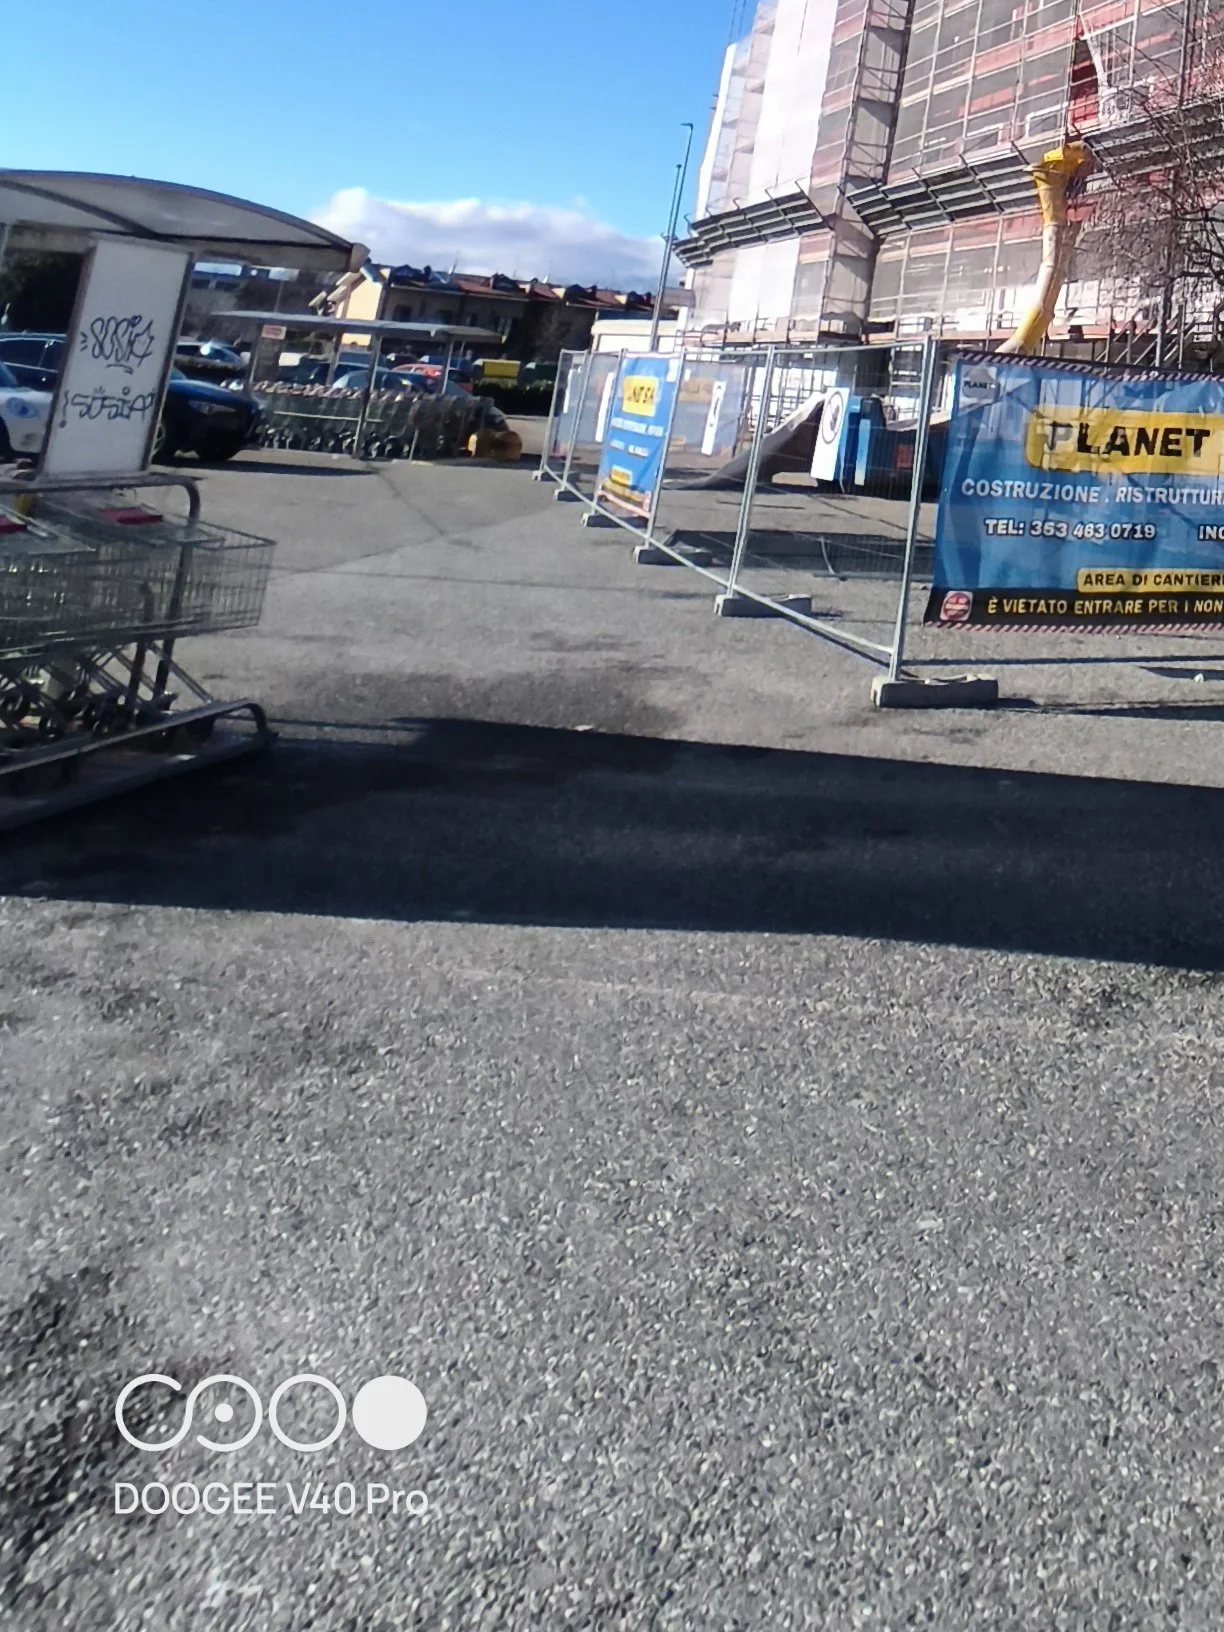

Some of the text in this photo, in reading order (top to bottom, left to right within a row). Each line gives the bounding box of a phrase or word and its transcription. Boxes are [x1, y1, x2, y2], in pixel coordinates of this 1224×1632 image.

[1046, 421, 1211, 459] PLANET
[962, 478, 1100, 503] COSTRUZIONE
[985, 518, 1024, 536] TEL:
[1110, 522, 1156, 540] 0719
[1083, 573, 1126, 586] AREA
[1132, 573, 1149, 586] DI
[987, 596, 998, 614] È
[1003, 598, 1068, 614] VIETATO
[1074, 599, 1143, 614] ENTRARE
[1149, 599, 1178, 614] PER
[1194, 599, 1224, 613] NON
